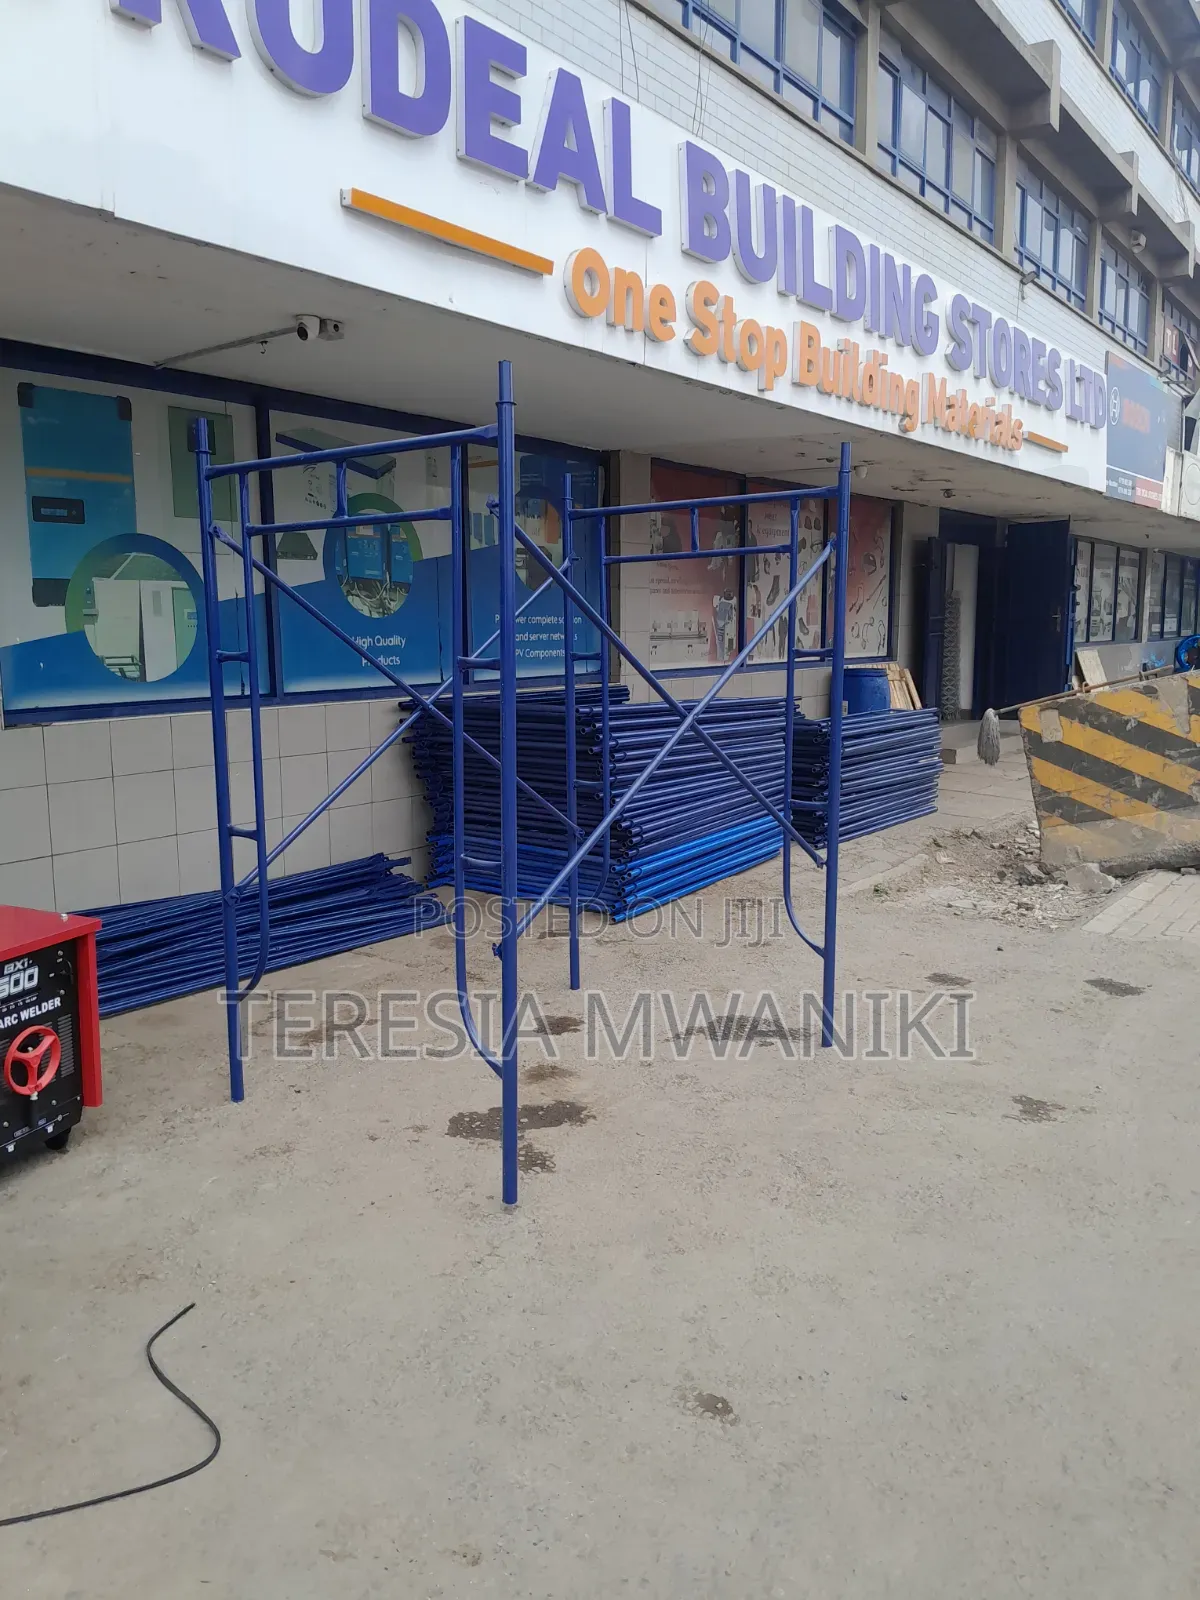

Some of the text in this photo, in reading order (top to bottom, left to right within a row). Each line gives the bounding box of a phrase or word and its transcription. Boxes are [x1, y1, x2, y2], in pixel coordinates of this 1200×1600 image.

[678, 140, 940, 357] BUILDING
[944, 294, 1063, 411] STORES
[1065, 358, 1107, 430] LTD
[563, 247, 1024, 451] One Stop Building Materials
[527, 615, 558, 626] complete
[375, 635, 406, 648] Quality
[515, 632, 529, 641] and
[529, 633, 549, 641] server
[525, 648, 565, 659] Components
[362, 655, 400, 666] Pducts
[20, 997, 61, 1021] WELDER
